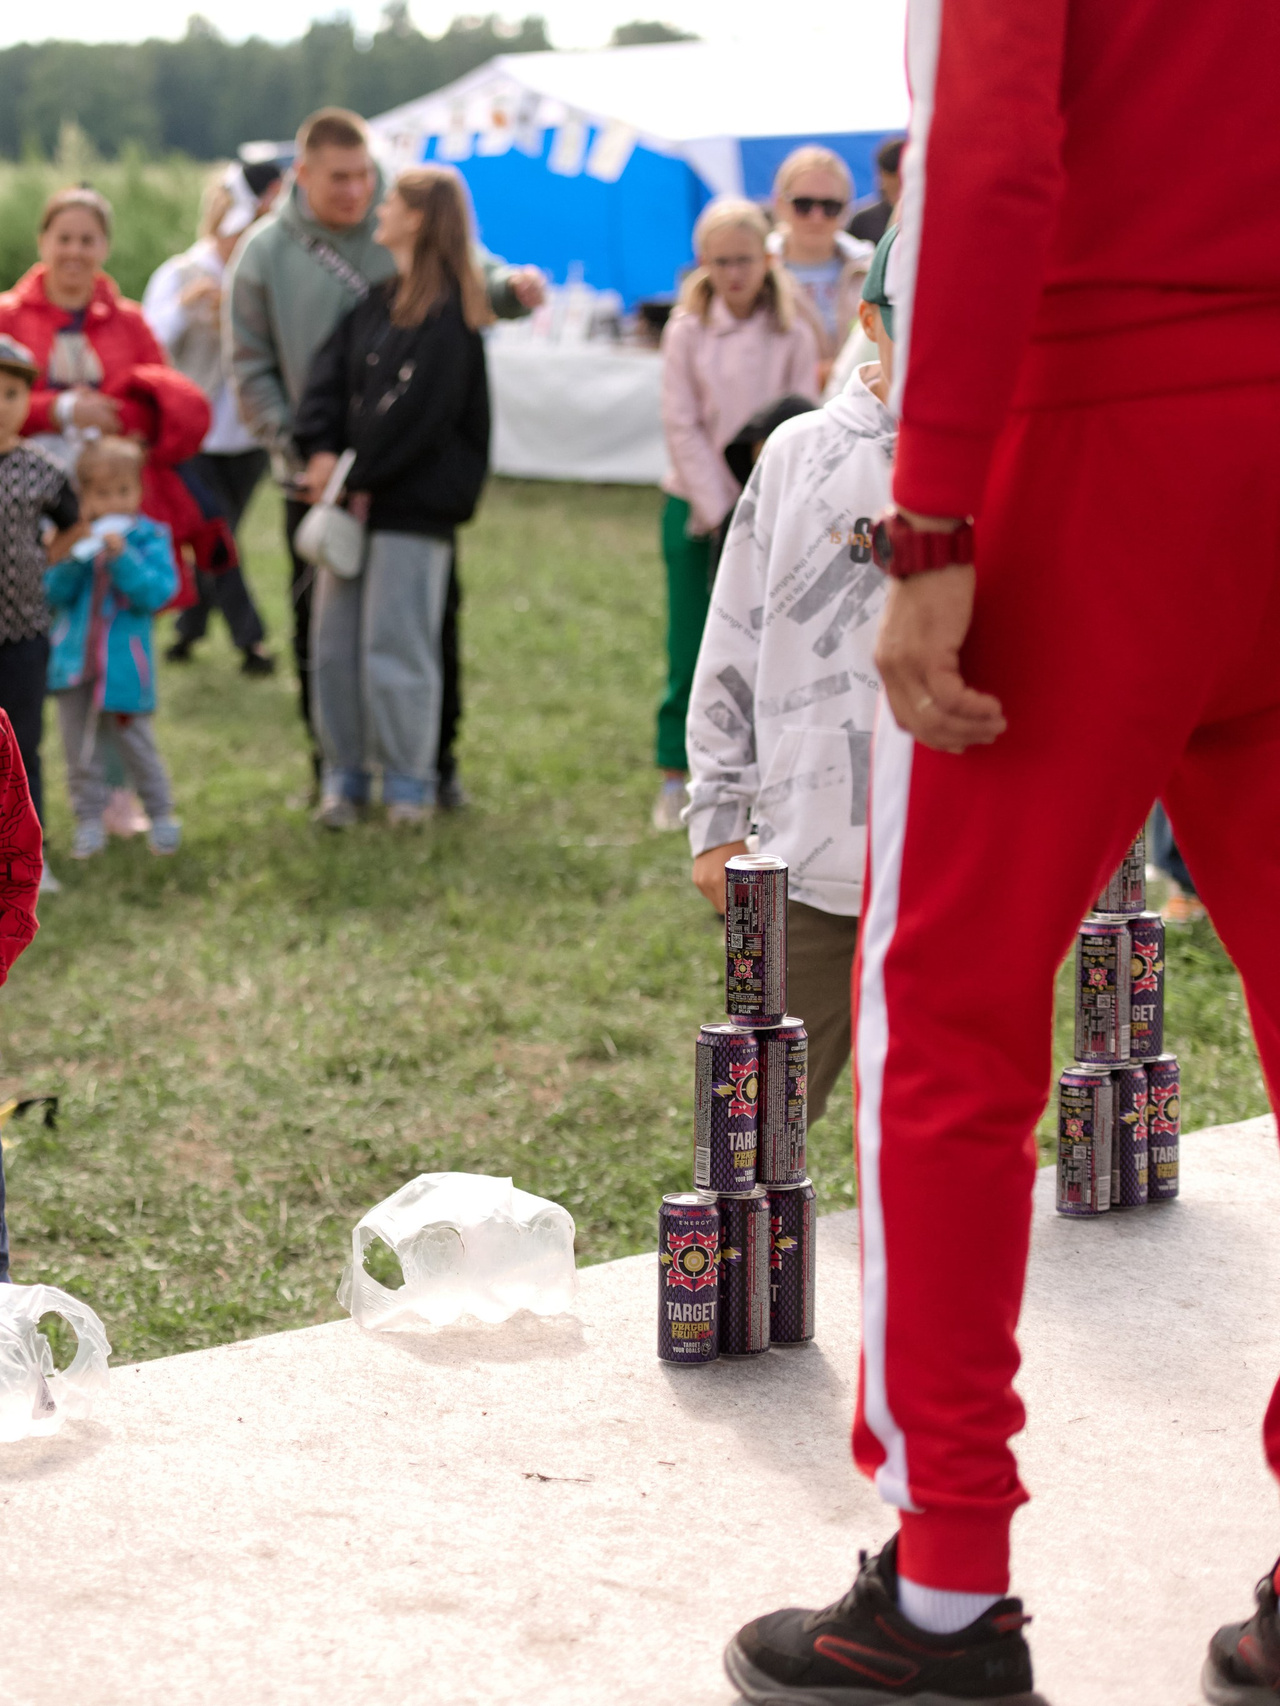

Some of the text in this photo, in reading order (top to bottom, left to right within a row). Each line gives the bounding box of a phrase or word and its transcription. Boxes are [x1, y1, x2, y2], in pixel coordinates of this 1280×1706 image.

[728, 1129, 757, 1150] TARG
[666, 1301, 717, 1321] TARGET
[671, 1322, 710, 1331] DRAGON
[671, 1330, 699, 1339] FRUIT
